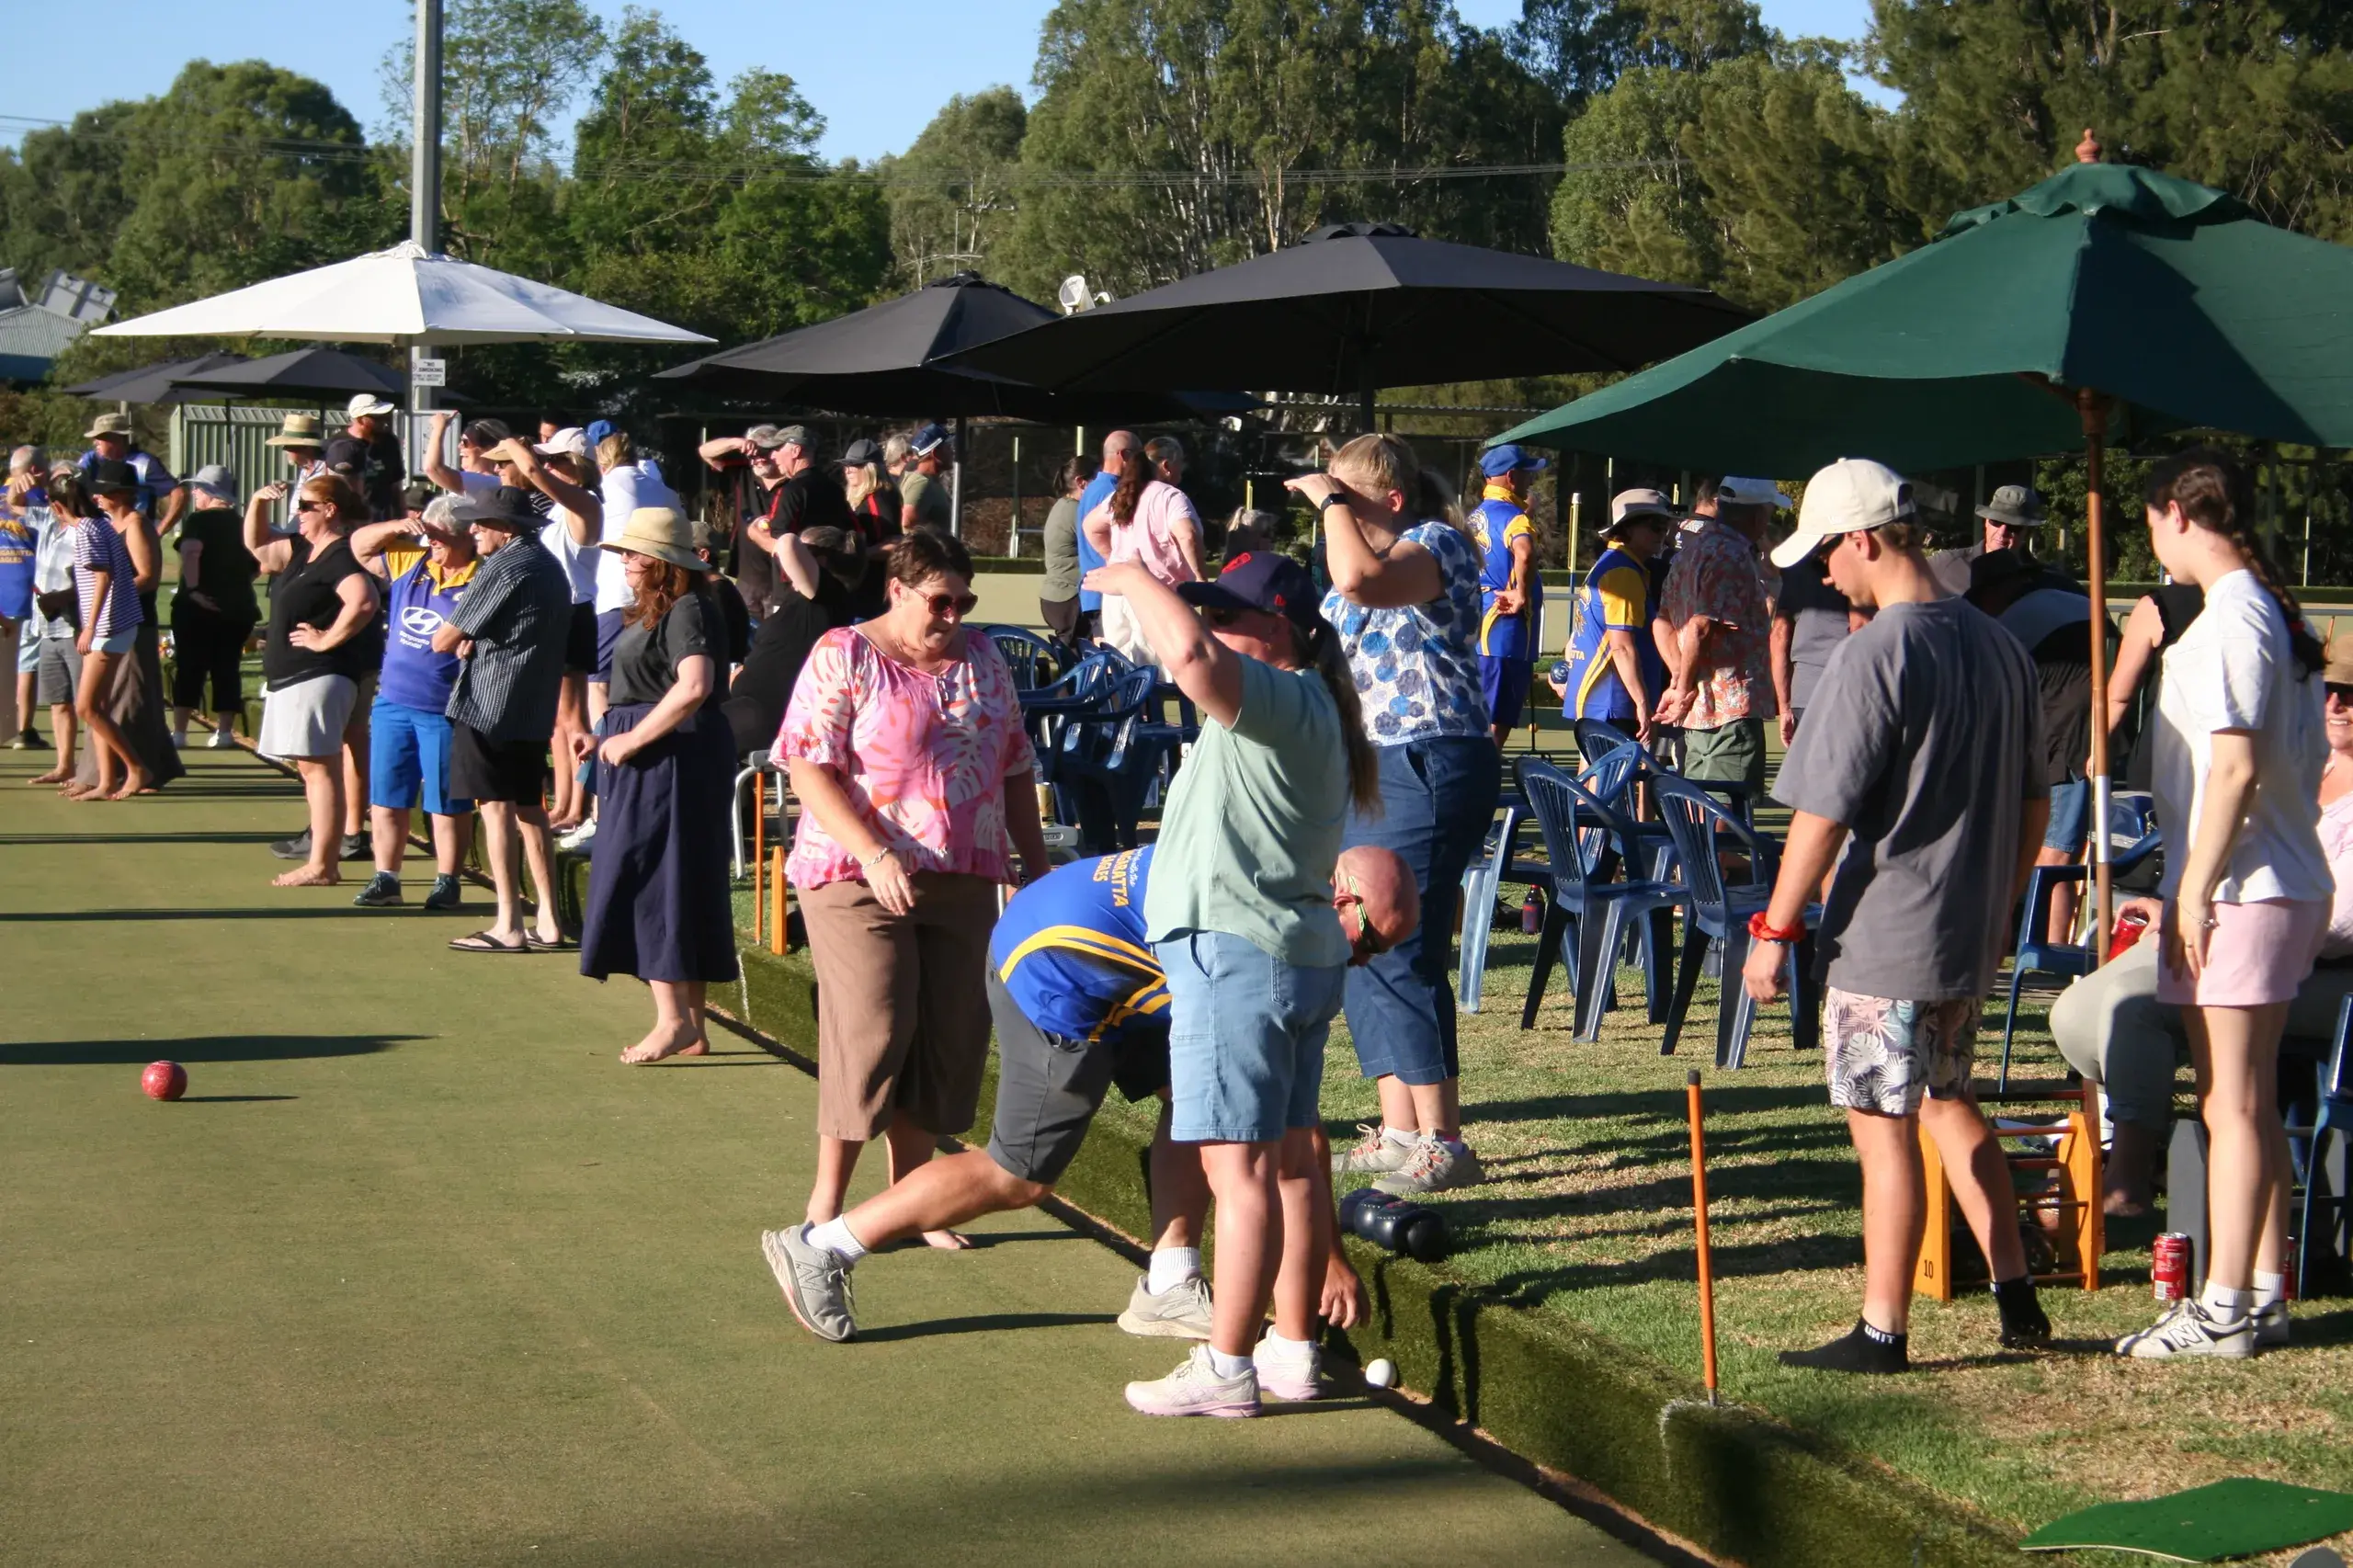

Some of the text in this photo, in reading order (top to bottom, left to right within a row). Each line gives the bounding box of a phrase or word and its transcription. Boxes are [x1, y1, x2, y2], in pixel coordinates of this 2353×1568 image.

[1111, 849, 1135, 906] NGARATTA
[1924, 1259, 1934, 1279] 10
[1864, 1324, 1895, 1344] UNIT
